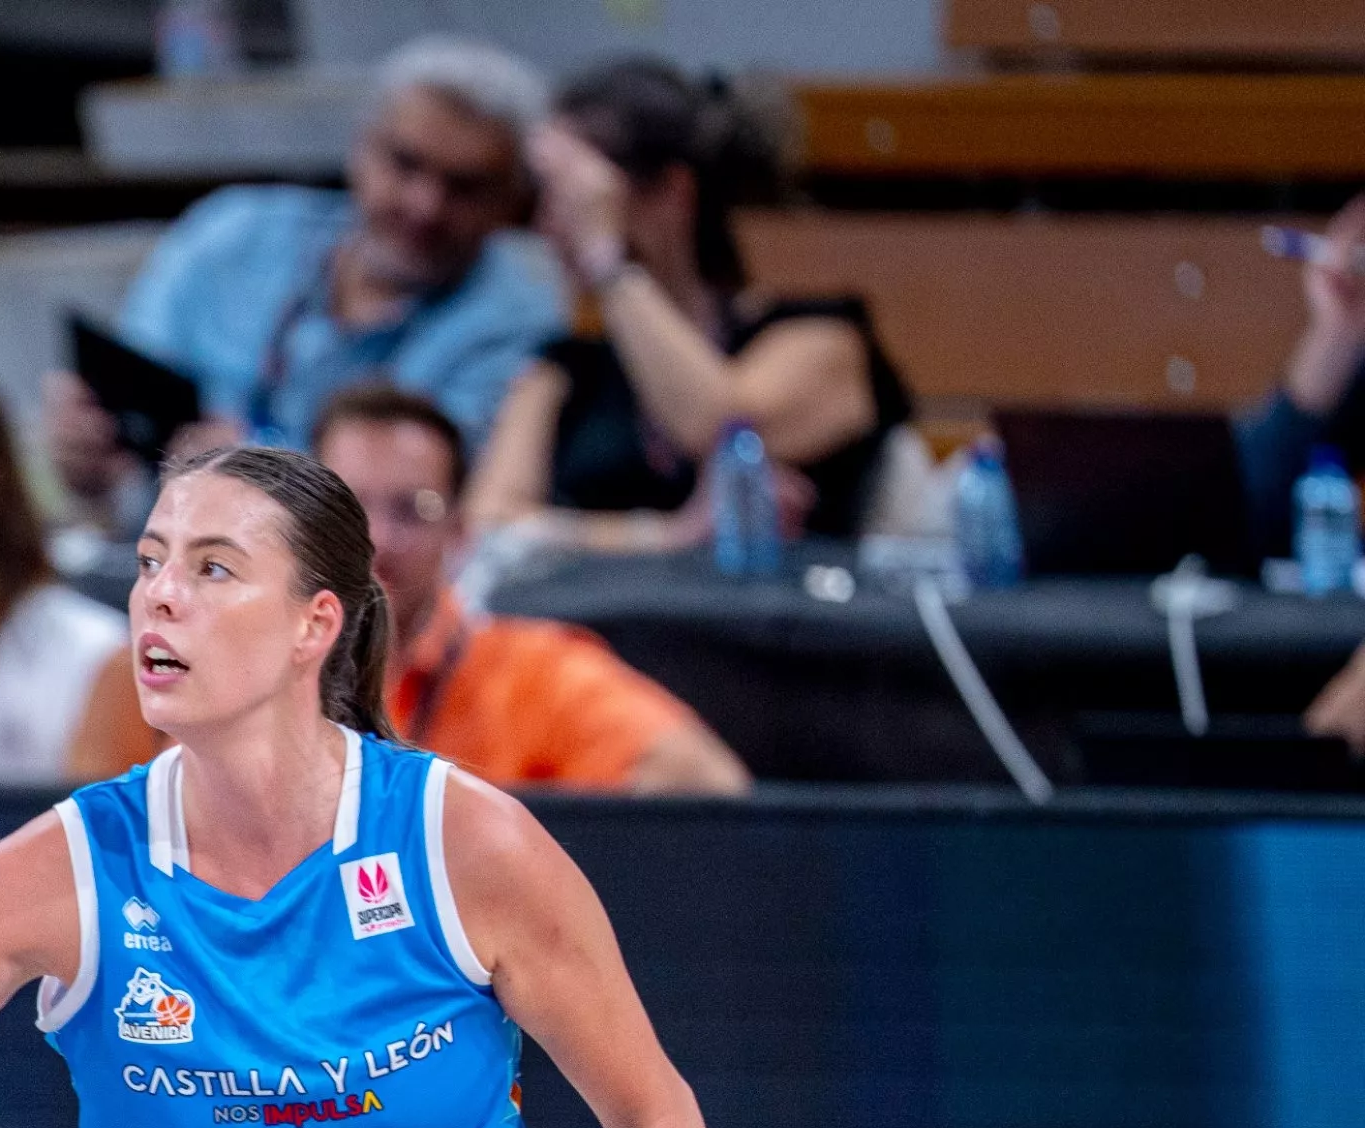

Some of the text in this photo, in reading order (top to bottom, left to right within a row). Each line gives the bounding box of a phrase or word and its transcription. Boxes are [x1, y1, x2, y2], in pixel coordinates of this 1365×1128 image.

[121, 1023, 192, 1041] AVENIDA
[123, 1020, 454, 1096] CASTILLA Y LEÓN
[214, 1089, 383, 1128] NOS IMPULSA
